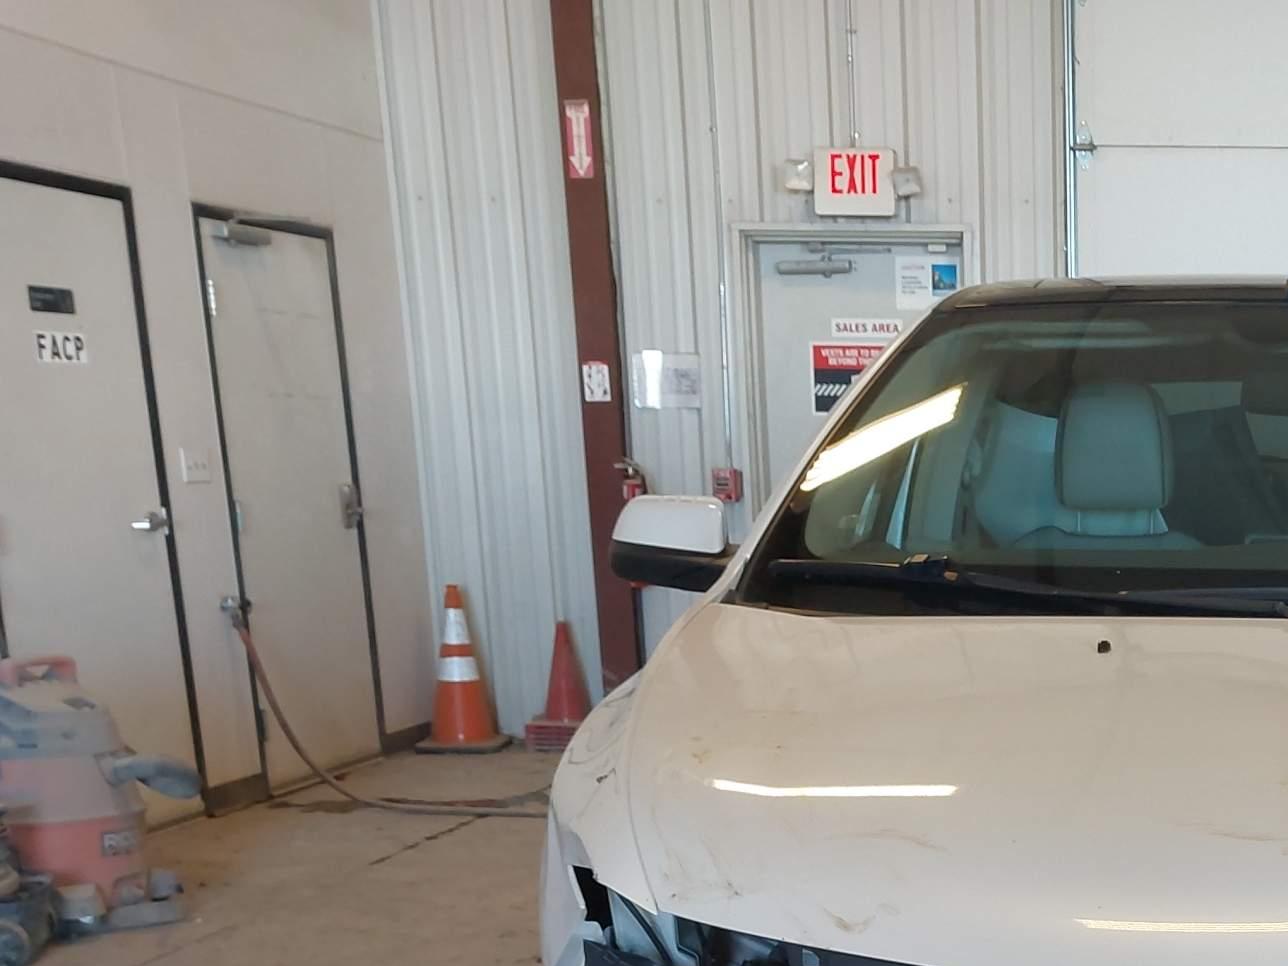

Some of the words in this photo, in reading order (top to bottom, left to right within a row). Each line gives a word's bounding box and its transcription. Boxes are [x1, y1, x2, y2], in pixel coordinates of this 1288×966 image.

[829, 153, 880, 194] EXIT
[835, 322, 868, 333] SALES
[871, 322, 900, 334] AREA
[37, 333, 84, 360] FACP
